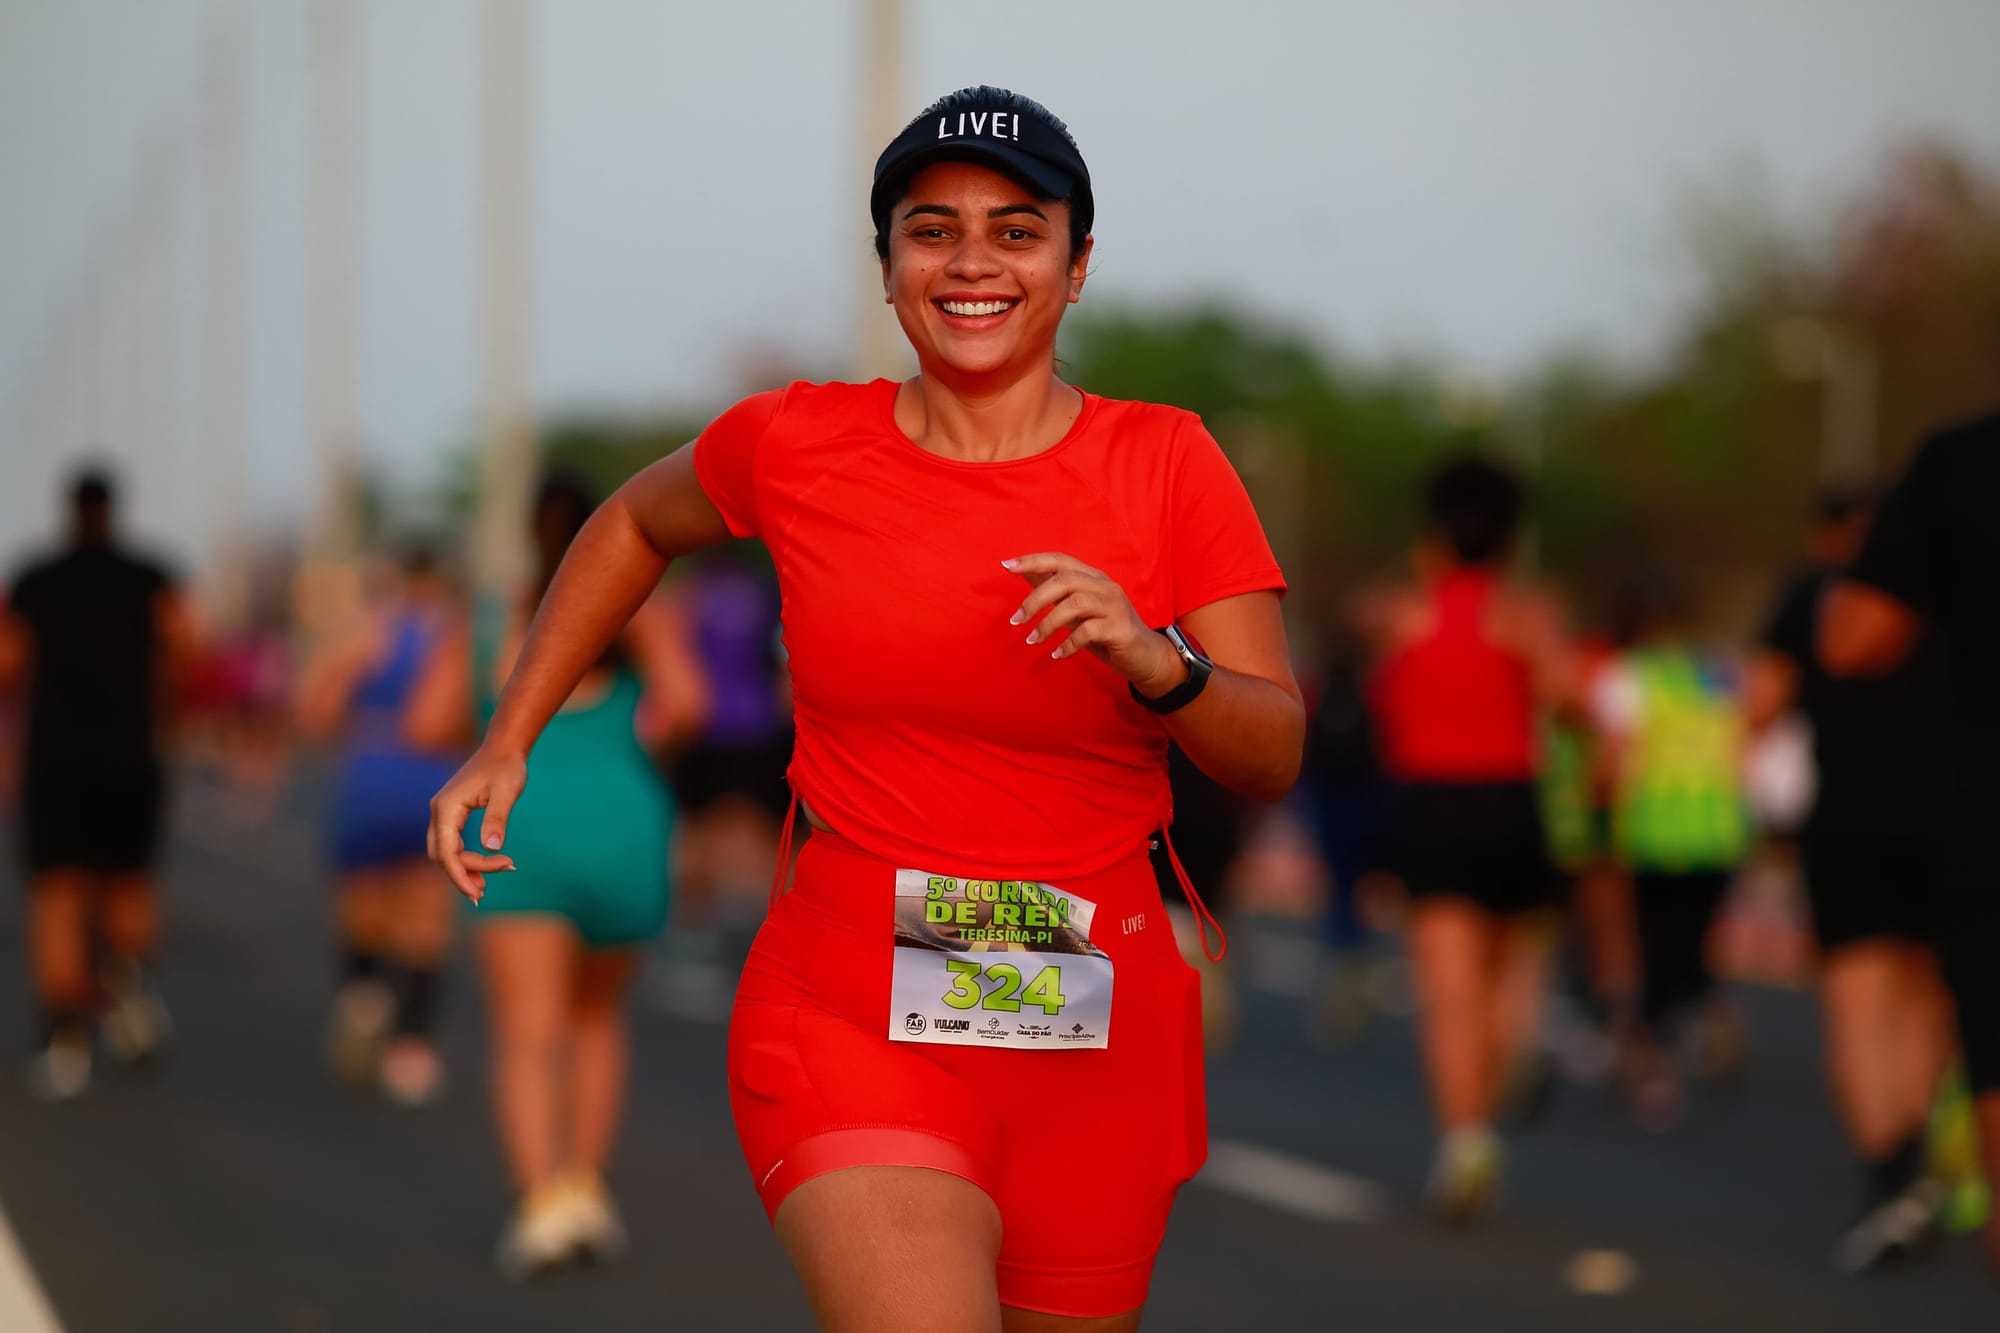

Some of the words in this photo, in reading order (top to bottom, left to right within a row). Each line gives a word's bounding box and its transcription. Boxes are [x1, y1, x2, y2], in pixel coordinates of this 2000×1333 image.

[938, 112, 1019, 141] LIVE!
[925, 901, 978, 924] DE
[993, 903, 1073, 928] REI
[1122, 913, 1146, 935] LIVE!
[959, 928, 1053, 944] TERESINA-PI
[941, 959, 1066, 1016] 324
[906, 1018, 923, 1028] FAR
[934, 1018, 970, 1031] VULCANO
